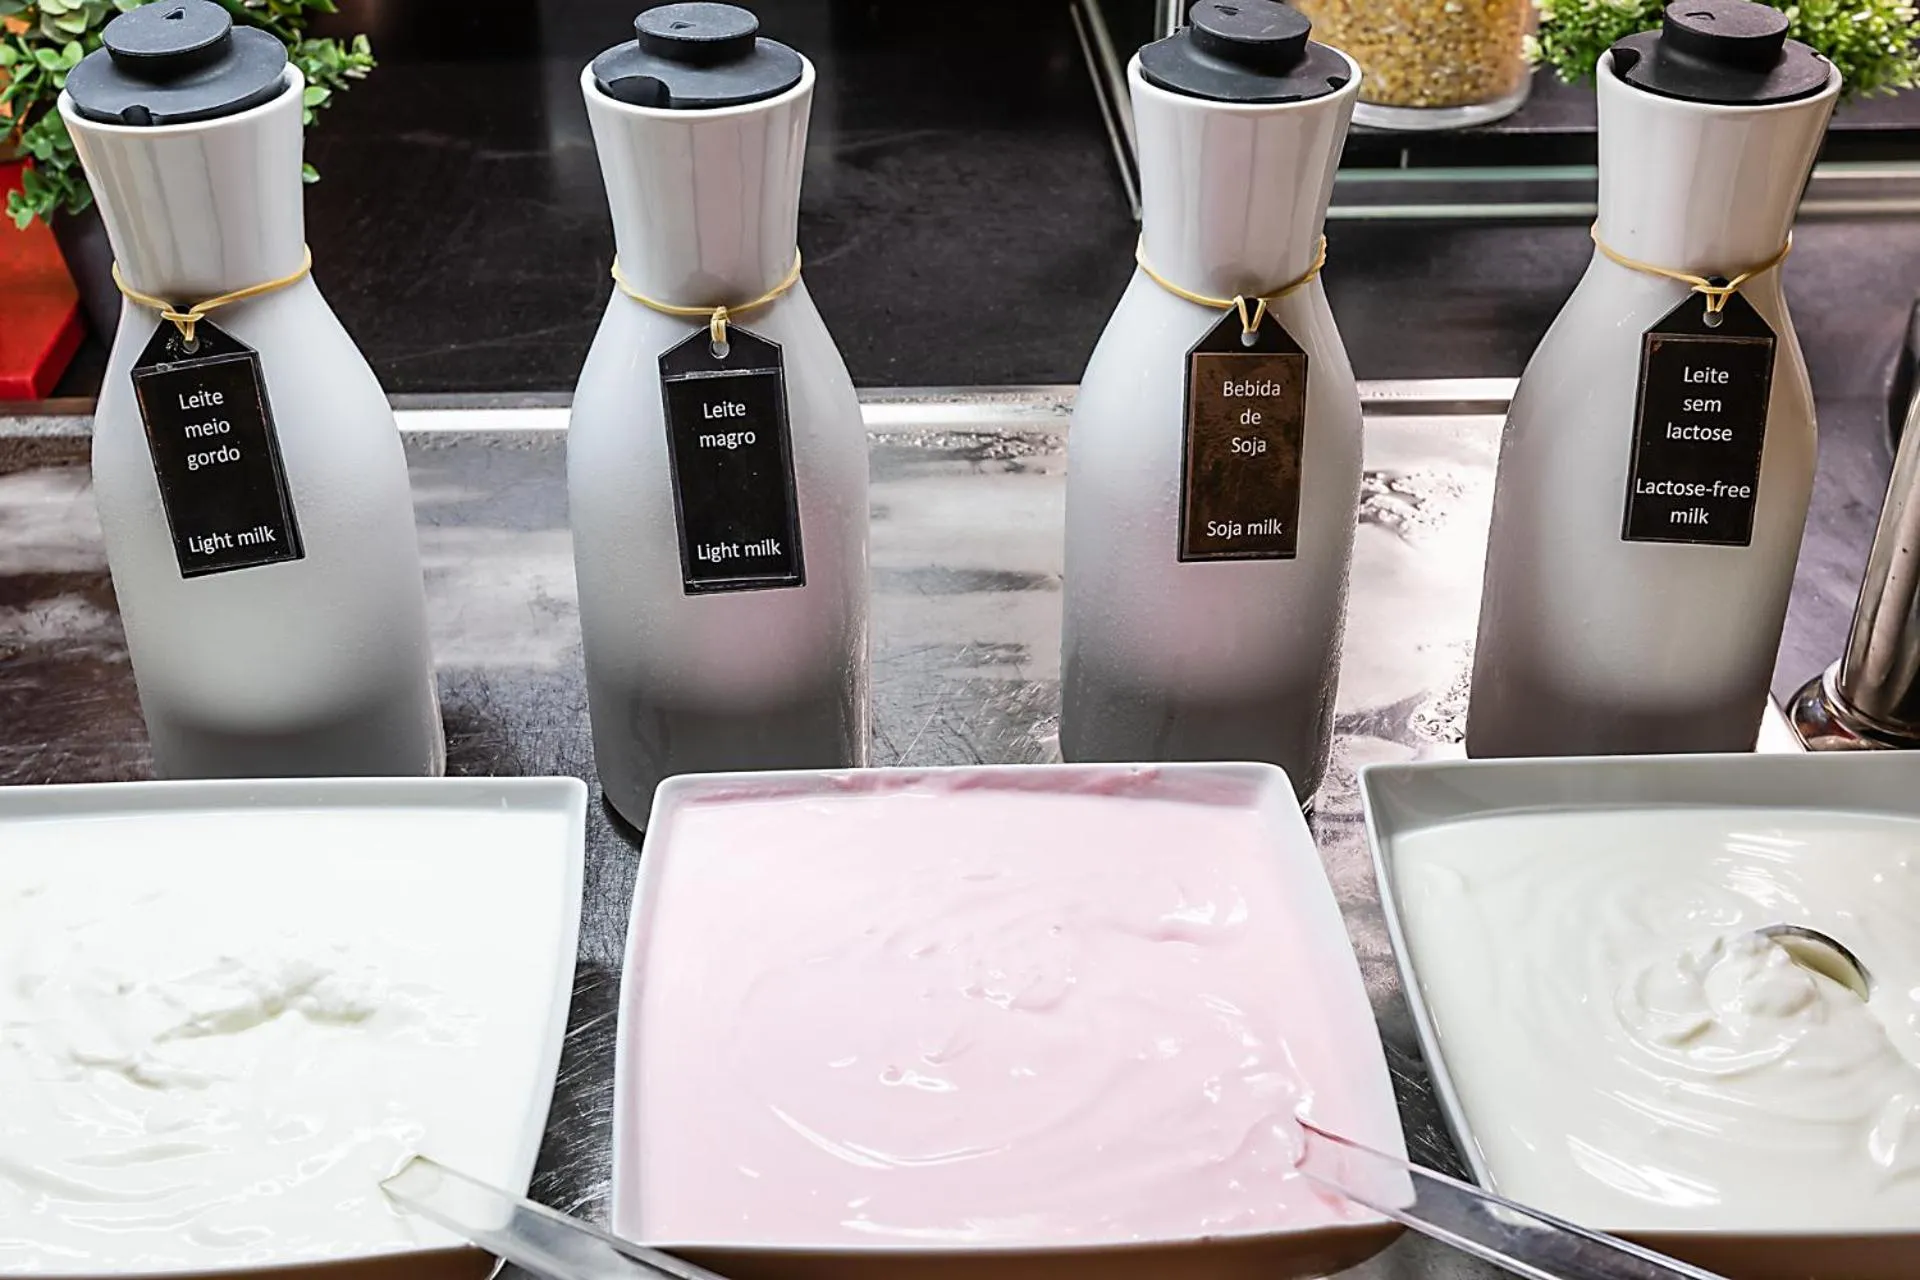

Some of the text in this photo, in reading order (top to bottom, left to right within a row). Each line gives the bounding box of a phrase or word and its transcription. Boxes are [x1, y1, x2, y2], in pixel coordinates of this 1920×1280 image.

[1683, 366, 1729, 384] Leite
[1223, 379, 1281, 397] Bebida
[178, 390, 224, 410] Leite
[703, 400, 746, 419] Leite
[1682, 398, 1722, 413] sem
[1239, 407, 1262, 425] de
[184, 417, 231, 439] meio
[1666, 421, 1733, 442] lactose
[699, 431, 756, 450] magro
[1231, 436, 1267, 457] Soja
[187, 444, 241, 471] gordo
[1636, 477, 1751, 499] Lactose-free
[1670, 507, 1709, 525] milk
[1206, 518, 1282, 540] Soja milk
[188, 525, 277, 555] Light milk
[697, 538, 782, 563] Light milk
